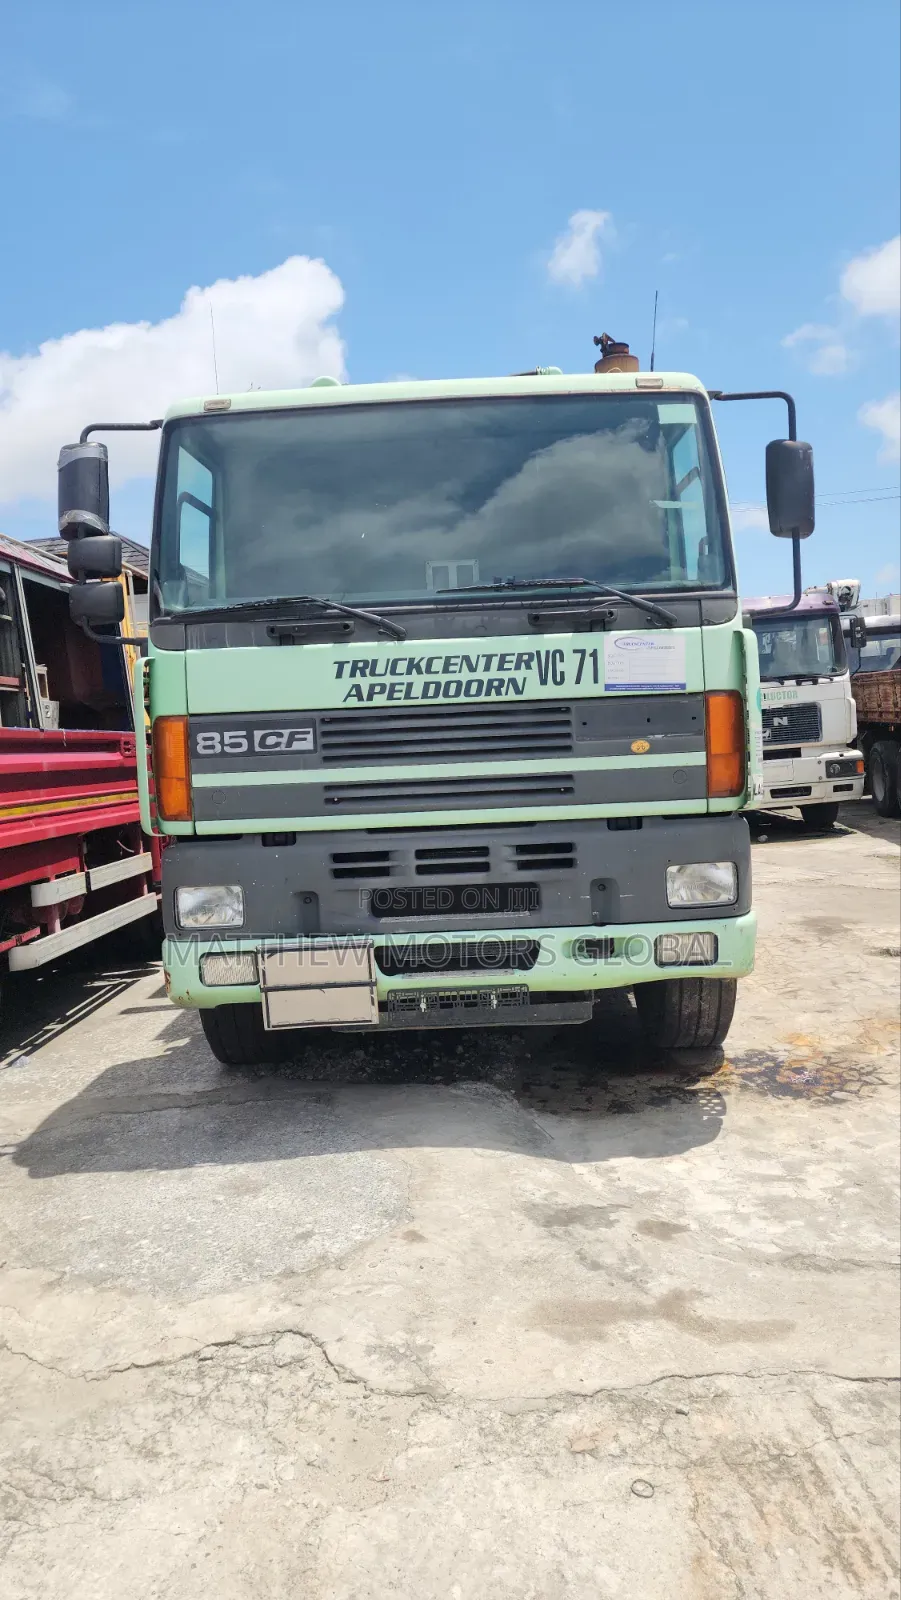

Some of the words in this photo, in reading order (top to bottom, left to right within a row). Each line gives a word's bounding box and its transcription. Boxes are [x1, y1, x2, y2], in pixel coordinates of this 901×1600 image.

[333, 652, 535, 679] TRUCKCENTER
[535, 649, 566, 686] VC
[572, 648, 599, 685] 71
[343, 677, 527, 703] APELDOORN
[196, 730, 249, 755] 85
[258, 730, 311, 750] CF
